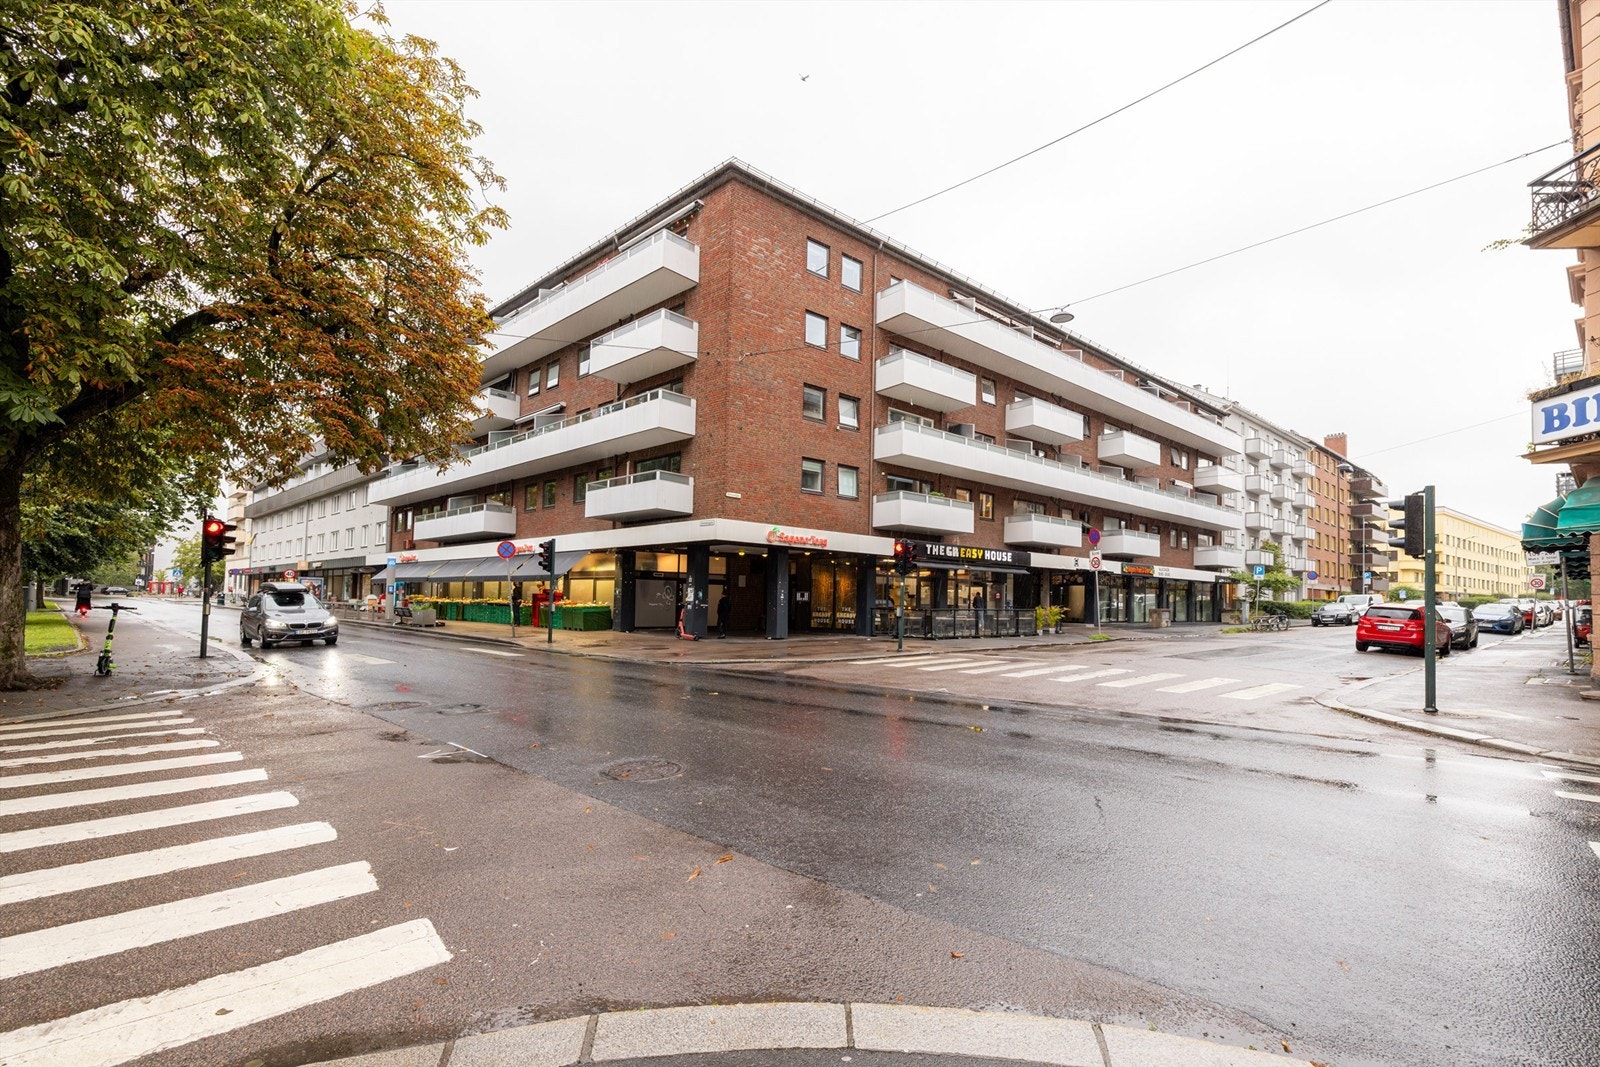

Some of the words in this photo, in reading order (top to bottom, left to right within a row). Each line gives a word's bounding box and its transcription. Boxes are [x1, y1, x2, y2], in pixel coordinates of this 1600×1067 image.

[926, 544, 945, 555] THE
[984, 550, 1012, 562] HOUSE
[1256, 566, 1262, 574] P
